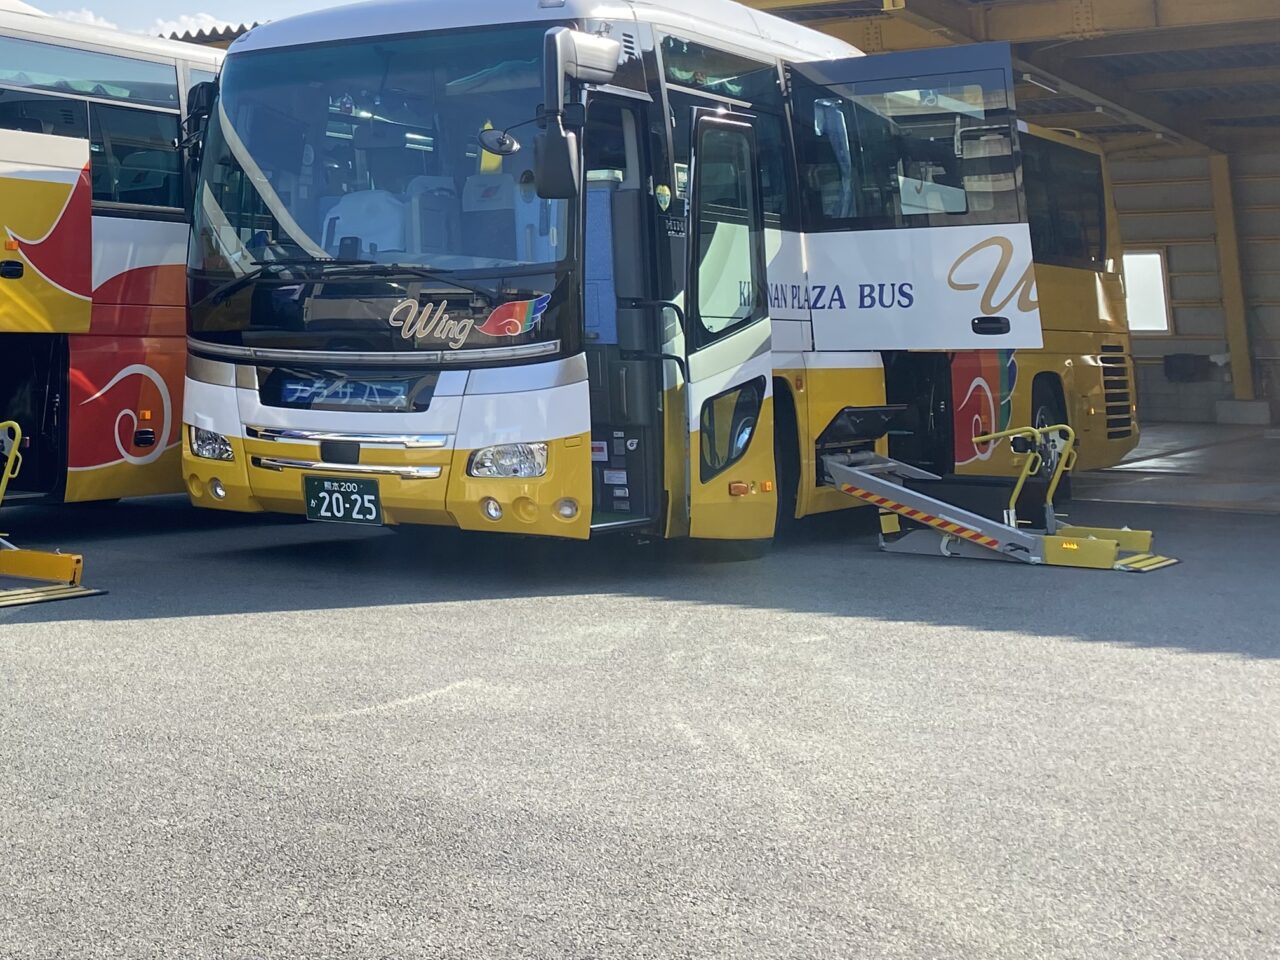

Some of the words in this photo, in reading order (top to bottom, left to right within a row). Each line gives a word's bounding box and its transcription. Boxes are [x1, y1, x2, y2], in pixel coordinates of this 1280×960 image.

[739, 281, 788, 309] KINAN
[791, 284, 846, 310] PLAZA
[858, 283, 914, 308] BUS
[389, 298, 475, 350] Wing
[318, 491, 377, 520] 20-25
